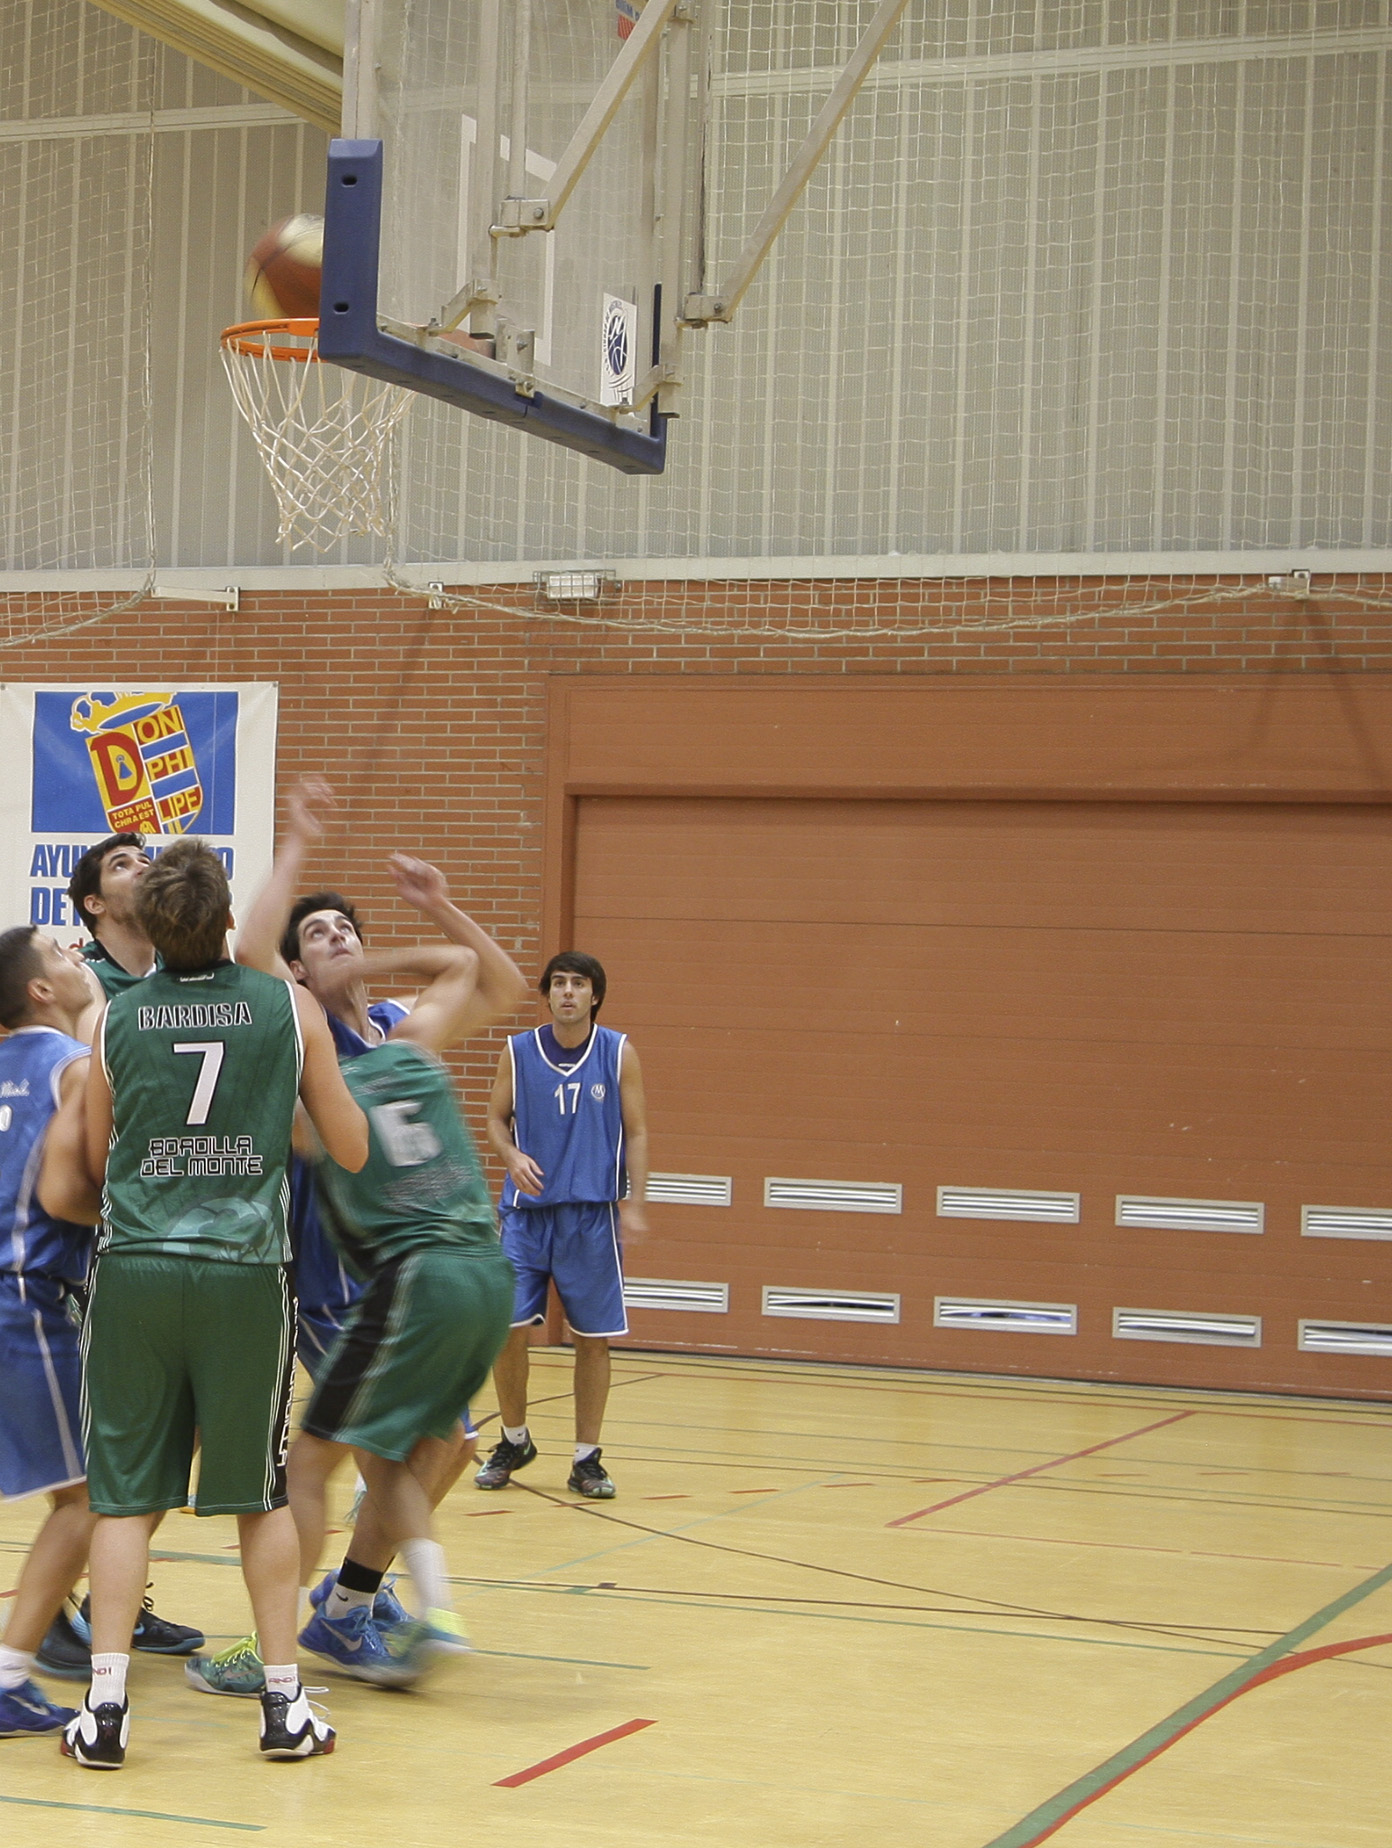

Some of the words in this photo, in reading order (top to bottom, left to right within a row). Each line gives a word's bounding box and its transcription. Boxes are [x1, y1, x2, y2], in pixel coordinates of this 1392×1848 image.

[136, 708, 183, 744] ON
[147, 748, 193, 781] PHI
[112, 807, 135, 820] TOTA
[135, 801, 152, 812] PUL
[157, 788, 200, 820] LIPE
[31, 887, 67, 926] DE
[138, 1002, 252, 1031] BARDISA
[173, 1040, 225, 1126] 7
[554, 1082, 581, 1115] 17
[149, 1135, 252, 1157] BOADILLA
[140, 1158, 184, 1177] DEL
[188, 1155, 263, 1176] MONTE
